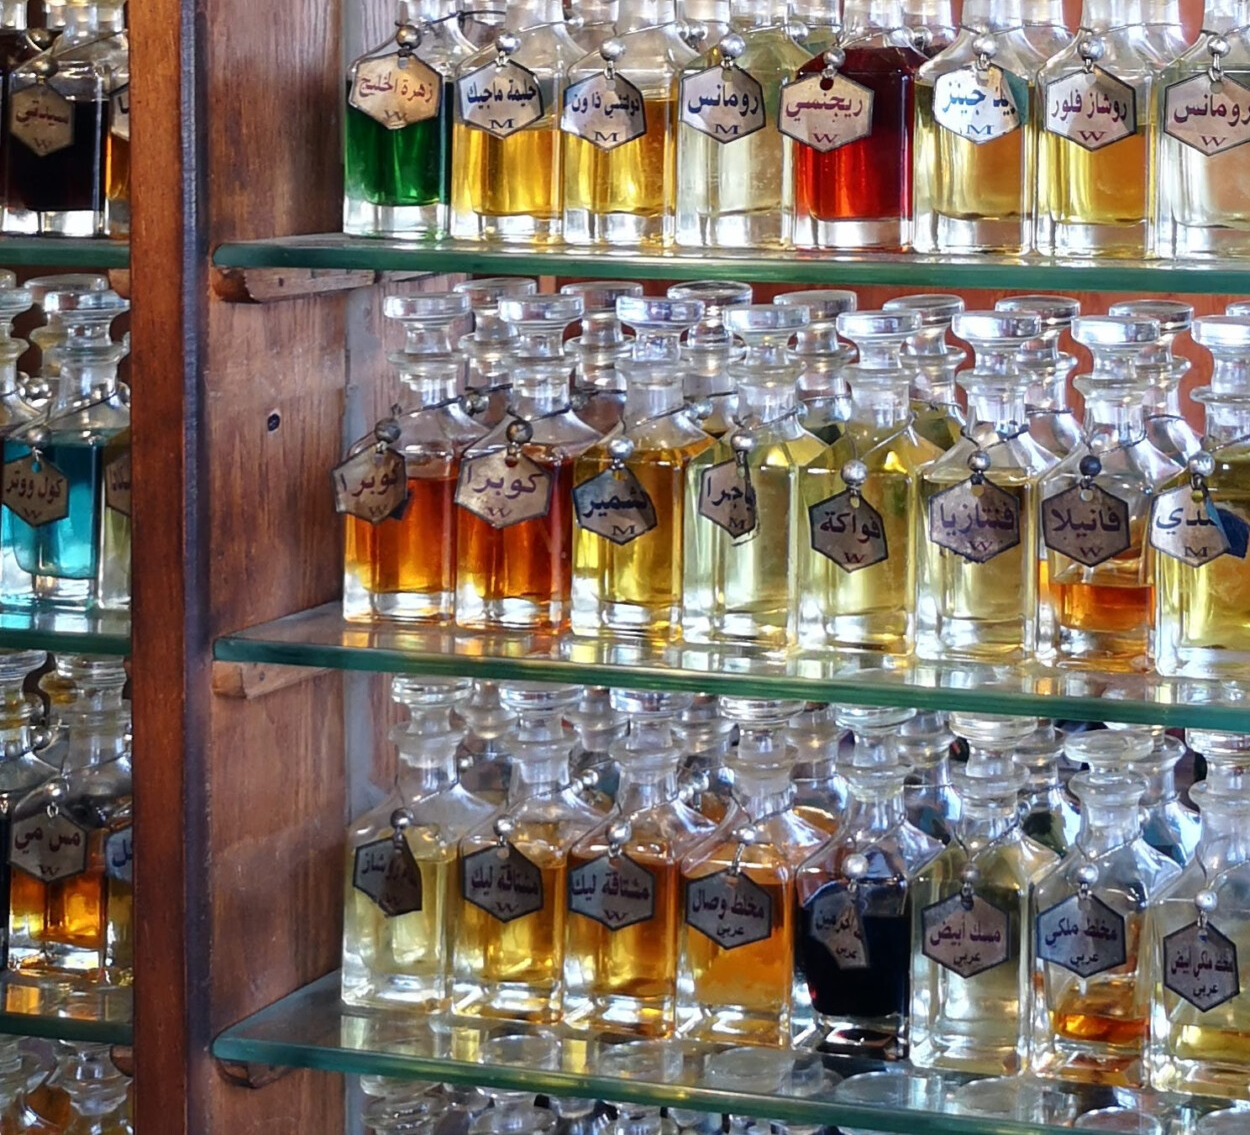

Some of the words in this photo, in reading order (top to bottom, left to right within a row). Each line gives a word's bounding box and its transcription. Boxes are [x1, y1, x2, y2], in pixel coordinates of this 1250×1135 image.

[358, 71, 398, 98] الخليج
[400, 79, 433, 103] زهرة
[466, 80, 504, 109] ماجيك
[687, 84, 758, 115] رومانس
[571, 94, 588, 114] ون
[785, 94, 863, 123] ريجنسي
[1051, 89, 1083, 121] فلور
[1086, 95, 1128, 122] روشاز
[384, 109, 407, 122] W
[488, 118, 516, 129] M
[714, 123, 741, 135] M
[966, 124, 994, 136] M
[593, 131, 621, 142] M
[812, 133, 839, 145] W
[1079, 130, 1108, 141] W
[1200, 135, 1228, 147] W
[467, 464, 543, 500] كوبرا
[23, 509, 41, 519] W
[484, 507, 512, 518] W
[727, 517, 746, 530] M
[820, 511, 881, 544] فواكة
[1052, 507, 1121, 540] فانيلا
[611, 525, 636, 537] M
[967, 541, 993, 552] W
[1079, 547, 1104, 558] W
[1184, 546, 1209, 558] M
[844, 552, 866, 564] W
[39, 865, 60, 876] W
[495, 902, 520, 913] W
[604, 910, 629, 922] W
[716, 923, 745, 939] عربي
[970, 921, 1001, 943] مسك
[953, 951, 981, 965] عربي
[1070, 953, 1100, 967] عربي
[1192, 984, 1218, 999] عربي
